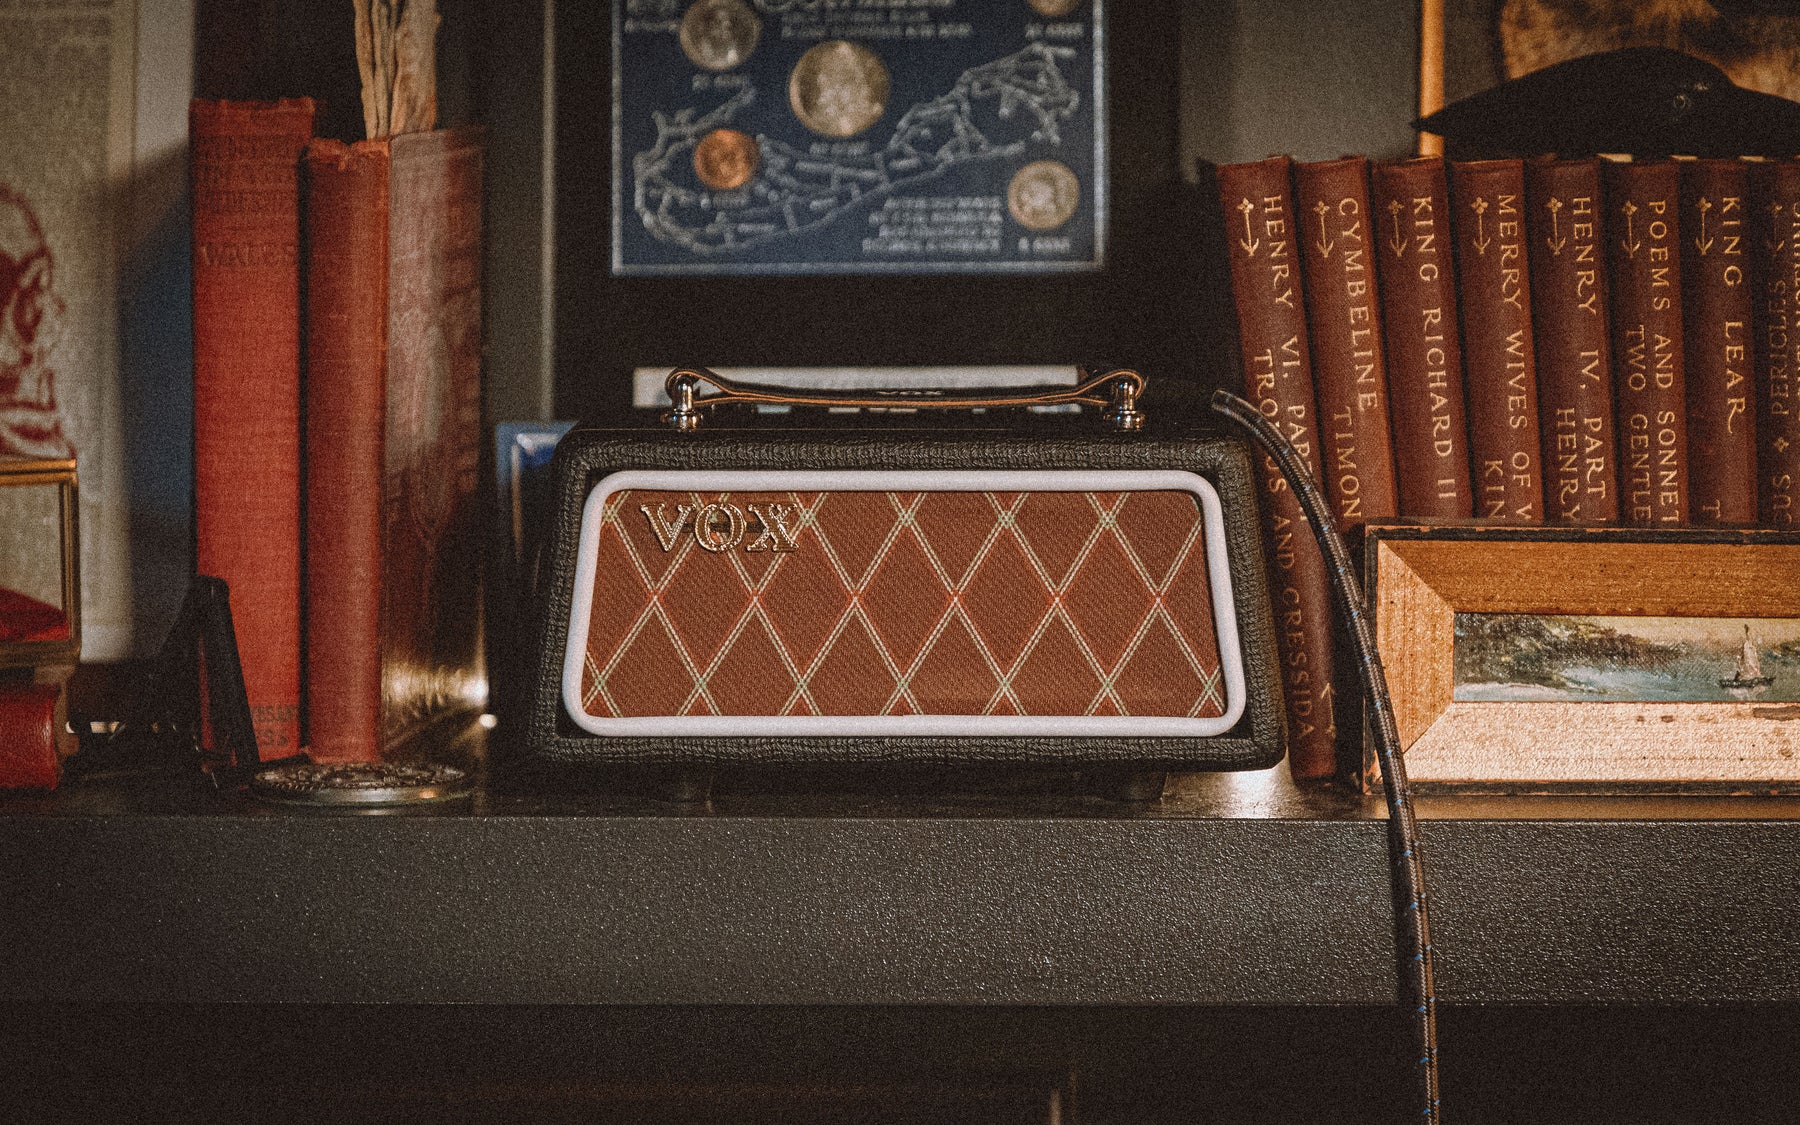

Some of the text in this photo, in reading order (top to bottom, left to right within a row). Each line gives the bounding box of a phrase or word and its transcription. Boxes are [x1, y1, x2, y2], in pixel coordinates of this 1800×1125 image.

[1338, 196, 1378, 413] CYMBELINE
[1498, 194, 1522, 310] MERRY
[1572, 196, 1597, 316] HENRY
[1263, 194, 1295, 309] HENRY
[1288, 404, 1313, 474] PAR
[1412, 195, 1457, 500] KING RICHARD II
[1648, 199, 1680, 522] POEMS AND SONNET
[1722, 196, 1746, 434] KING LEAR
[1767, 279, 1790, 416] PERICLES
[1506, 329, 1529, 429] WIVES
[1627, 324, 1652, 520] TWO GENTLE
[1333, 405, 1363, 521] TIMON
[1484, 459, 1507, 519] KIN
[1512, 451, 1532, 488] OF
[1556, 407, 1581, 520] HENRY
[1584, 416, 1607, 500] PART
[640, 503, 800, 552] VOX
[1272, 514, 1295, 570] AND
[1281, 588, 1315, 738] CRESSIDA
